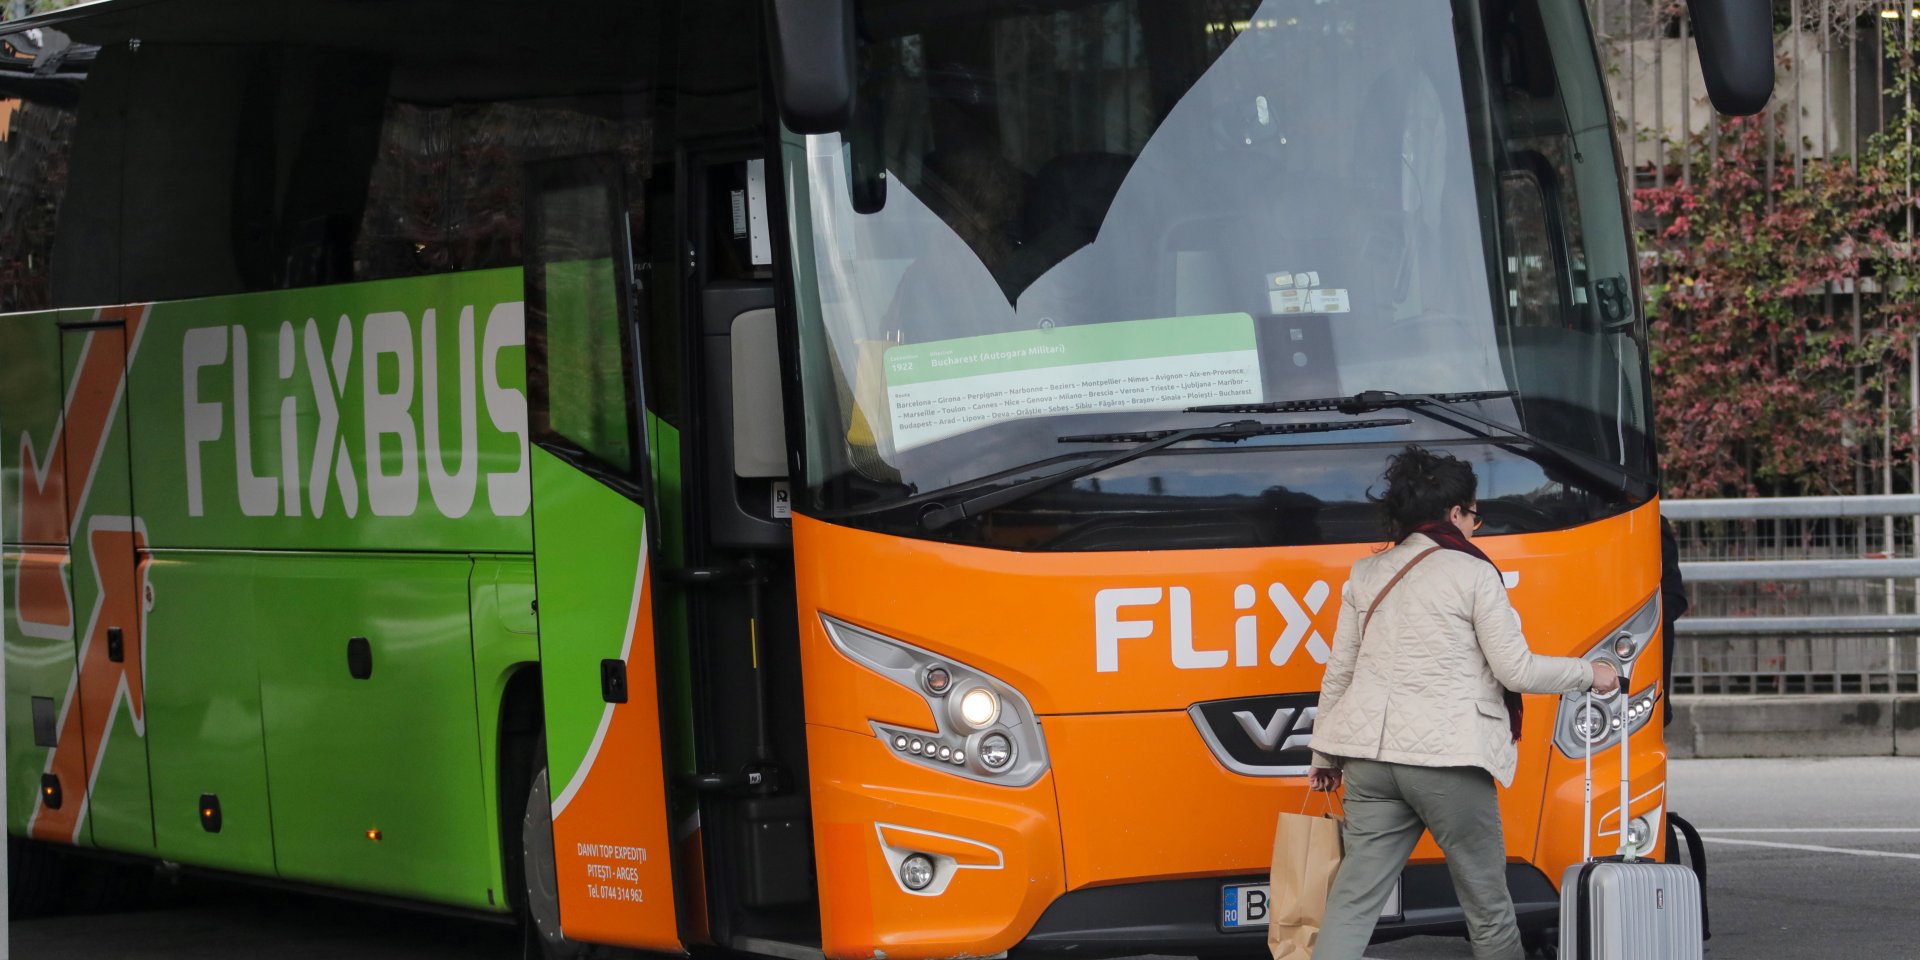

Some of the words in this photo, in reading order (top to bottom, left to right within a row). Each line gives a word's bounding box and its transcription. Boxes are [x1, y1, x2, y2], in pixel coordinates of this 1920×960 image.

[892, 362, 913, 372] 1922
[931, 354, 979, 367] Bucharest
[981, 350, 1026, 363] (Autogara
[897, 400, 931, 409] Barcelona
[938, 395, 961, 404] Girona
[968, 391, 1003, 400] Perpignan
[1010, 386, 1043, 395] Narbonne
[1082, 378, 1121, 387] Montpellier
[1155, 373, 1183, 381] Avignon
[1190, 369, 1244, 378] Aix-en-Provence
[904, 409, 935, 419] Marseille
[942, 405, 966, 414] Toulon
[973, 402, 998, 410] Cannes
[1027, 396, 1053, 404] Genova
[1089, 390, 1114, 398] Brescia
[1181, 382, 1211, 390] Ljubljana
[900, 421, 932, 430] Budapest
[939, 417, 956, 425] Arad
[962, 414, 985, 423] Lipova
[1076, 402, 1092, 410] Sibiu
[1161, 394, 1181, 402] Sinaia
[1219, 389, 1252, 397] Bucharest
[577, 842, 599, 857] DANVI
[600, 844, 614, 858] TOP
[588, 884, 600, 898] Tel.
[600, 885, 617, 900] 0744
[617, 887, 630, 901] 314
[630, 888, 644, 902] 962
[1225, 909, 1237, 922] RO
